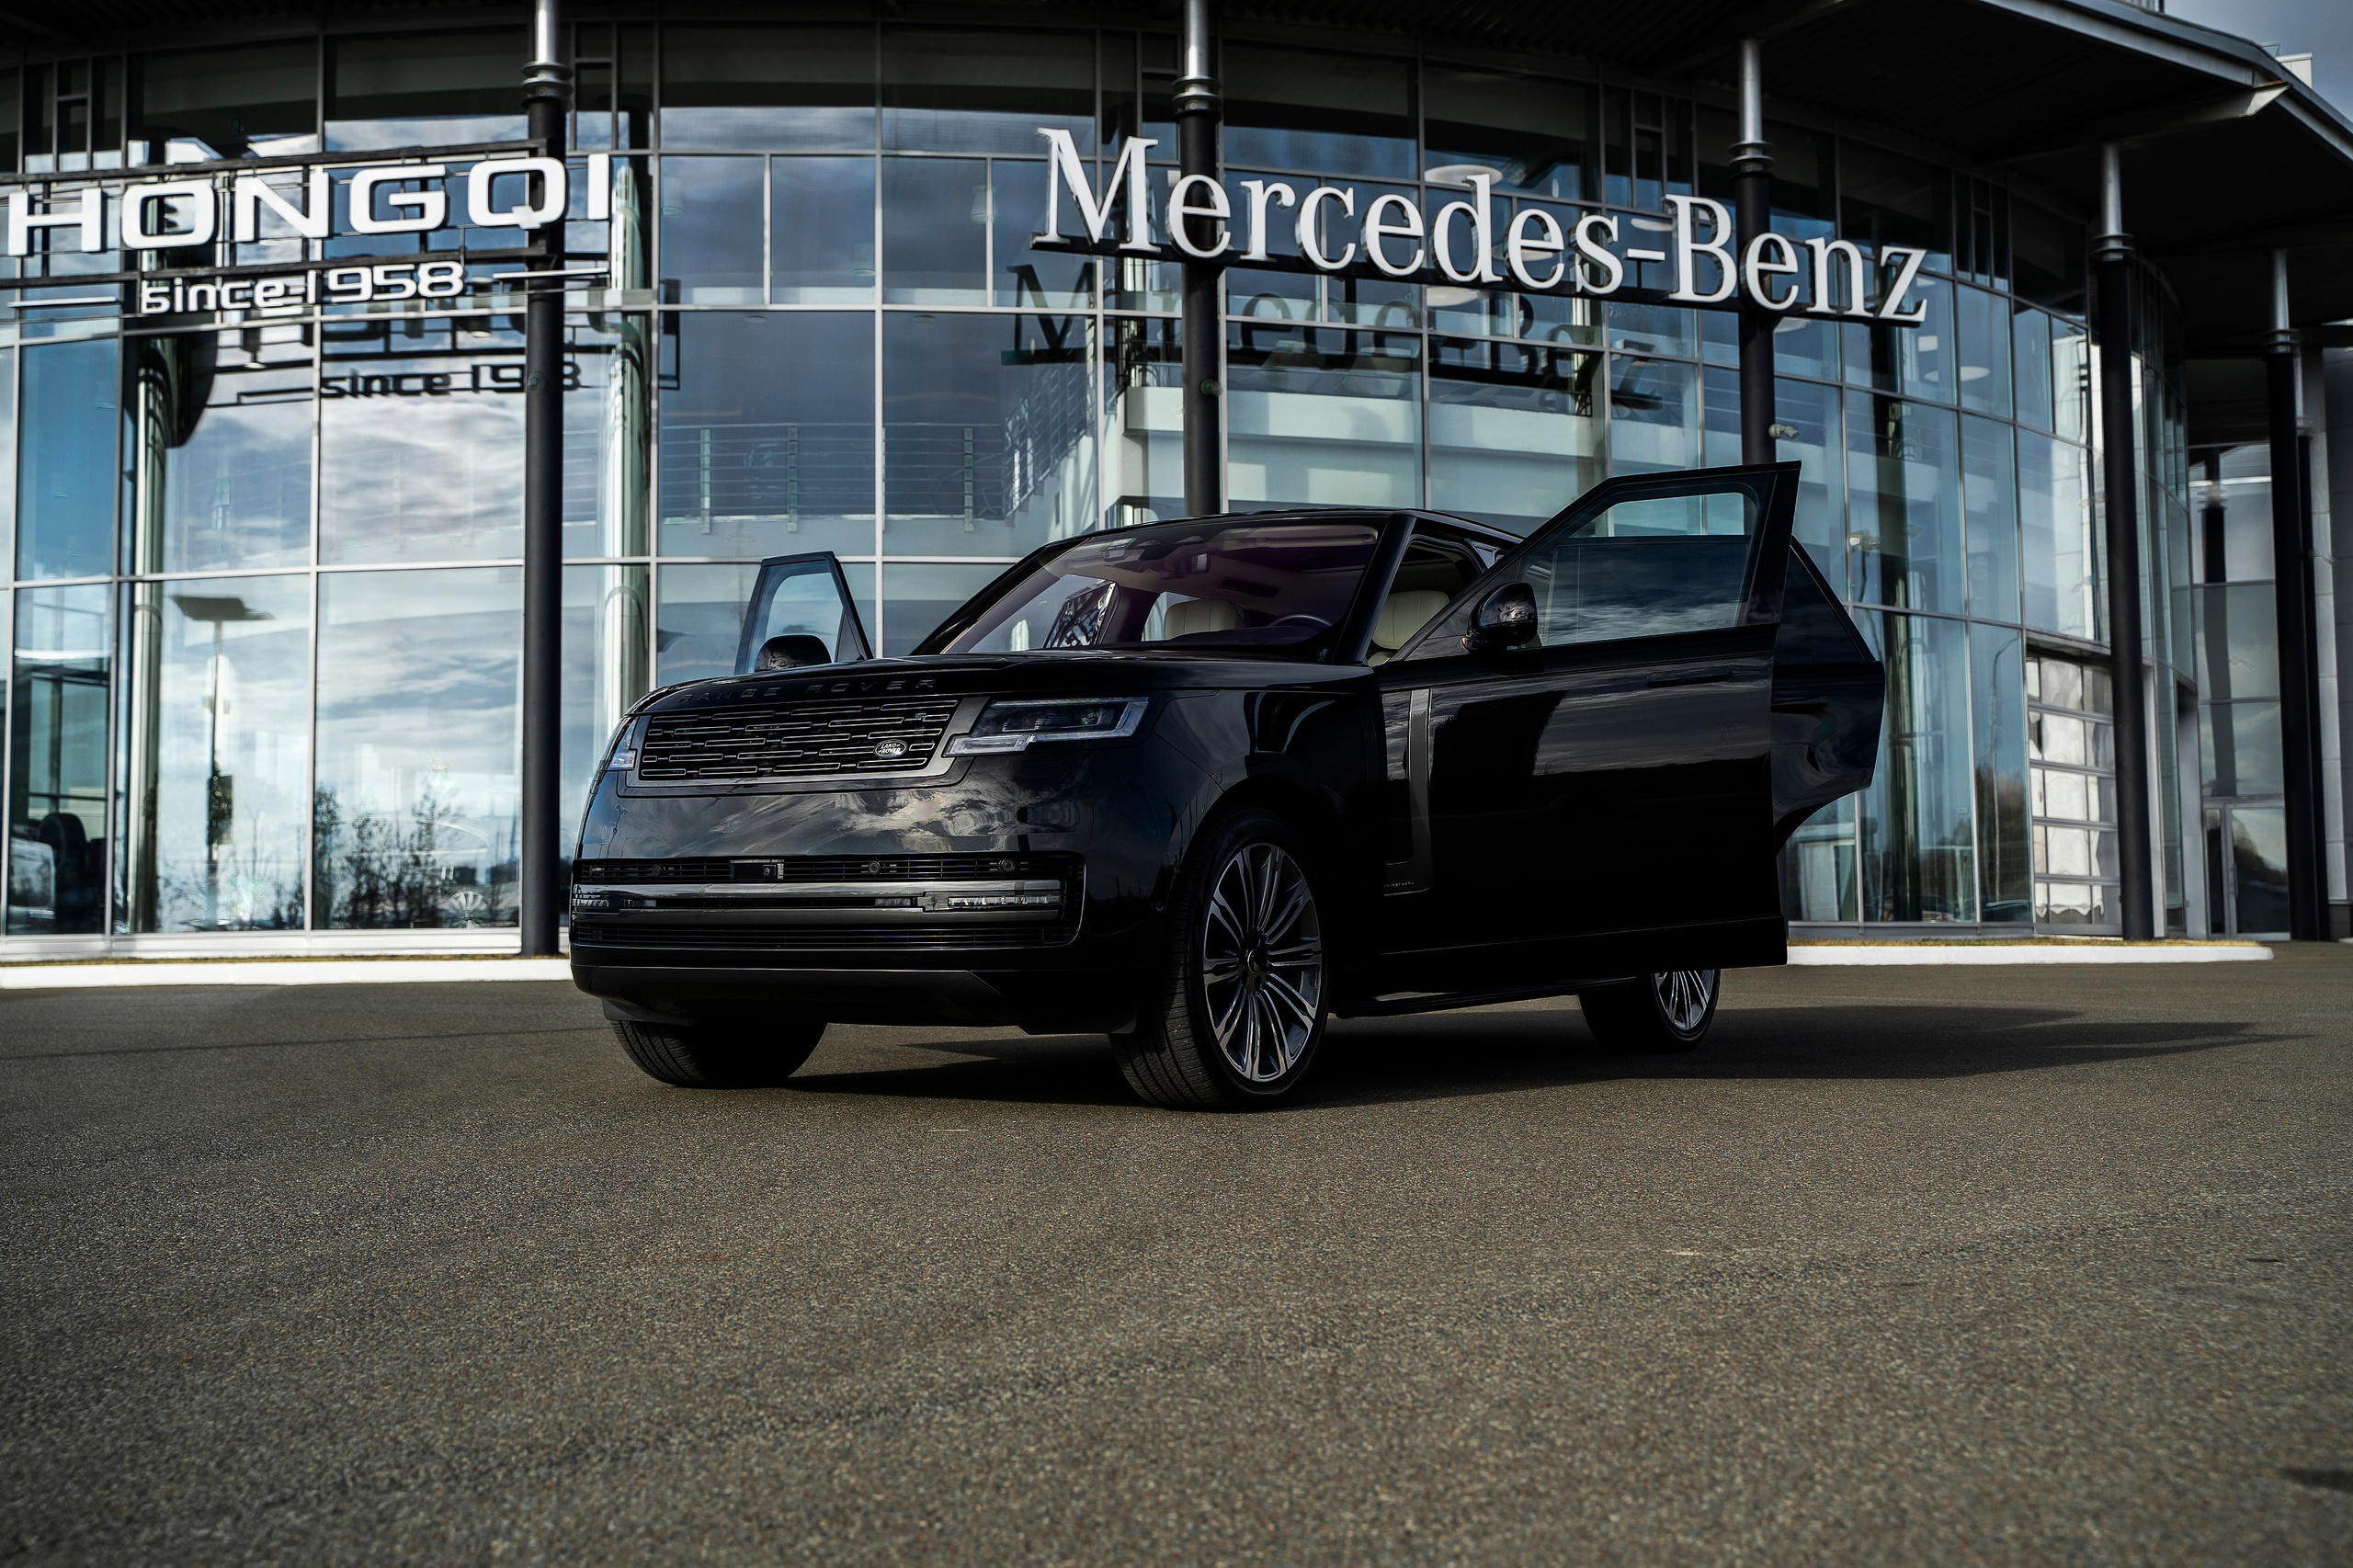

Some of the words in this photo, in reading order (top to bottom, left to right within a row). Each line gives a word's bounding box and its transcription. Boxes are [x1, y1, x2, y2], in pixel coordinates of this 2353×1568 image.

[6, 153, 611, 258] HONGQI
[1038, 127, 1928, 324] Mercedes-Benz
[141, 278, 289, 314] since
[305, 261, 465, 305] 1958
[678, 687, 781, 700] RANGE
[804, 678, 937, 694] ROVER
